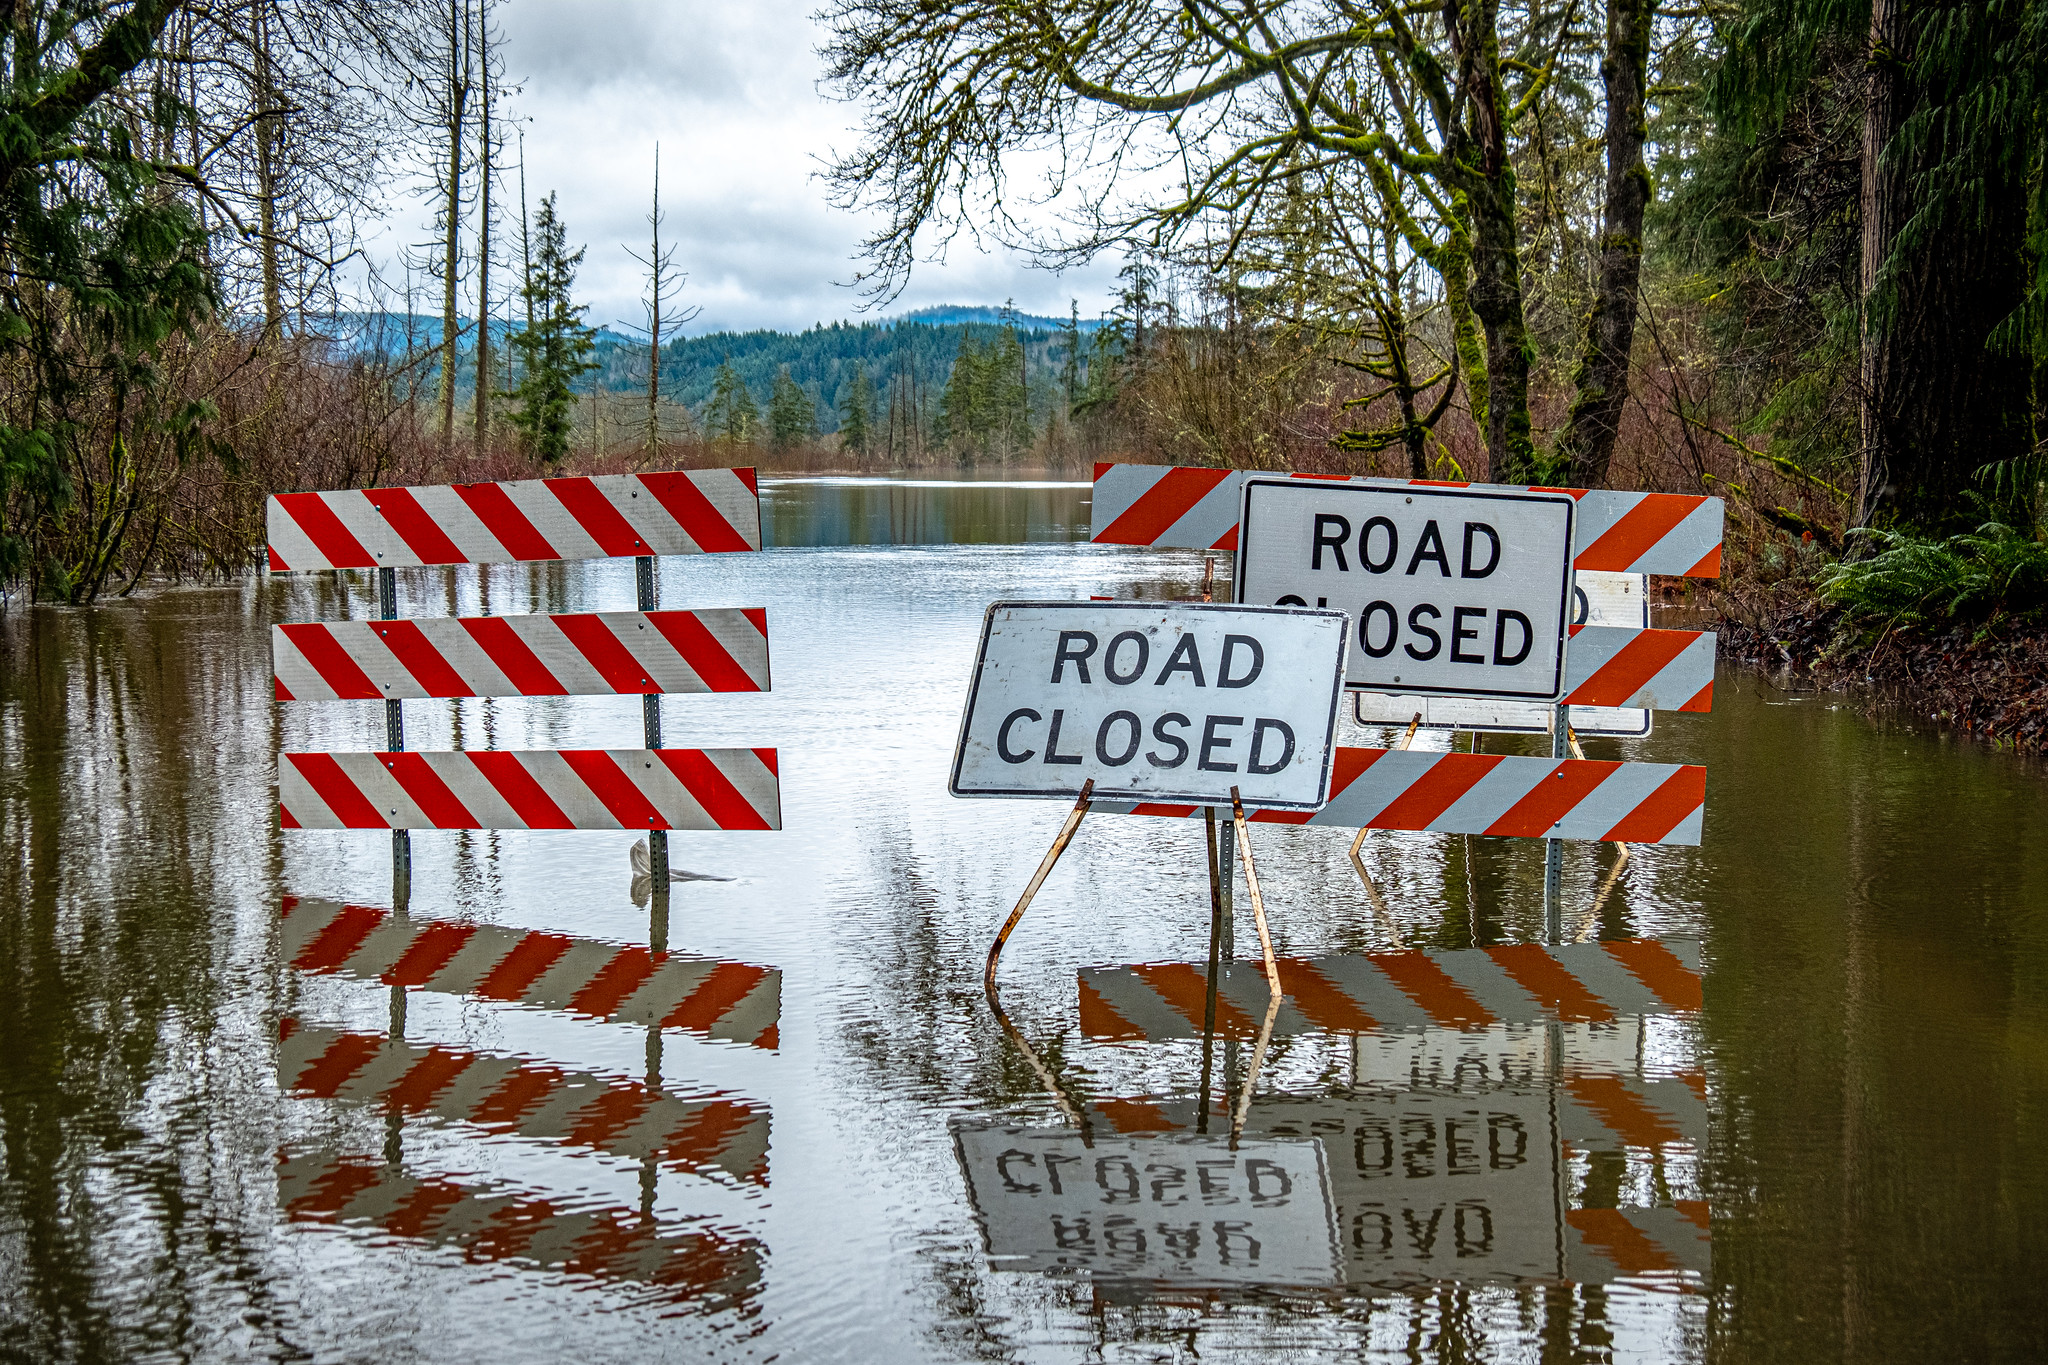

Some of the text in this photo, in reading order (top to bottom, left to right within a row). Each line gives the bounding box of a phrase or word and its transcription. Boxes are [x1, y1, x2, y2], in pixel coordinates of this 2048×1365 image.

[1311, 513, 1501, 579] ROAD
[1050, 630, 1265, 689] ROAD
[1275, 594, 1534, 667] OSED
[997, 707, 1296, 775] CLOSED
